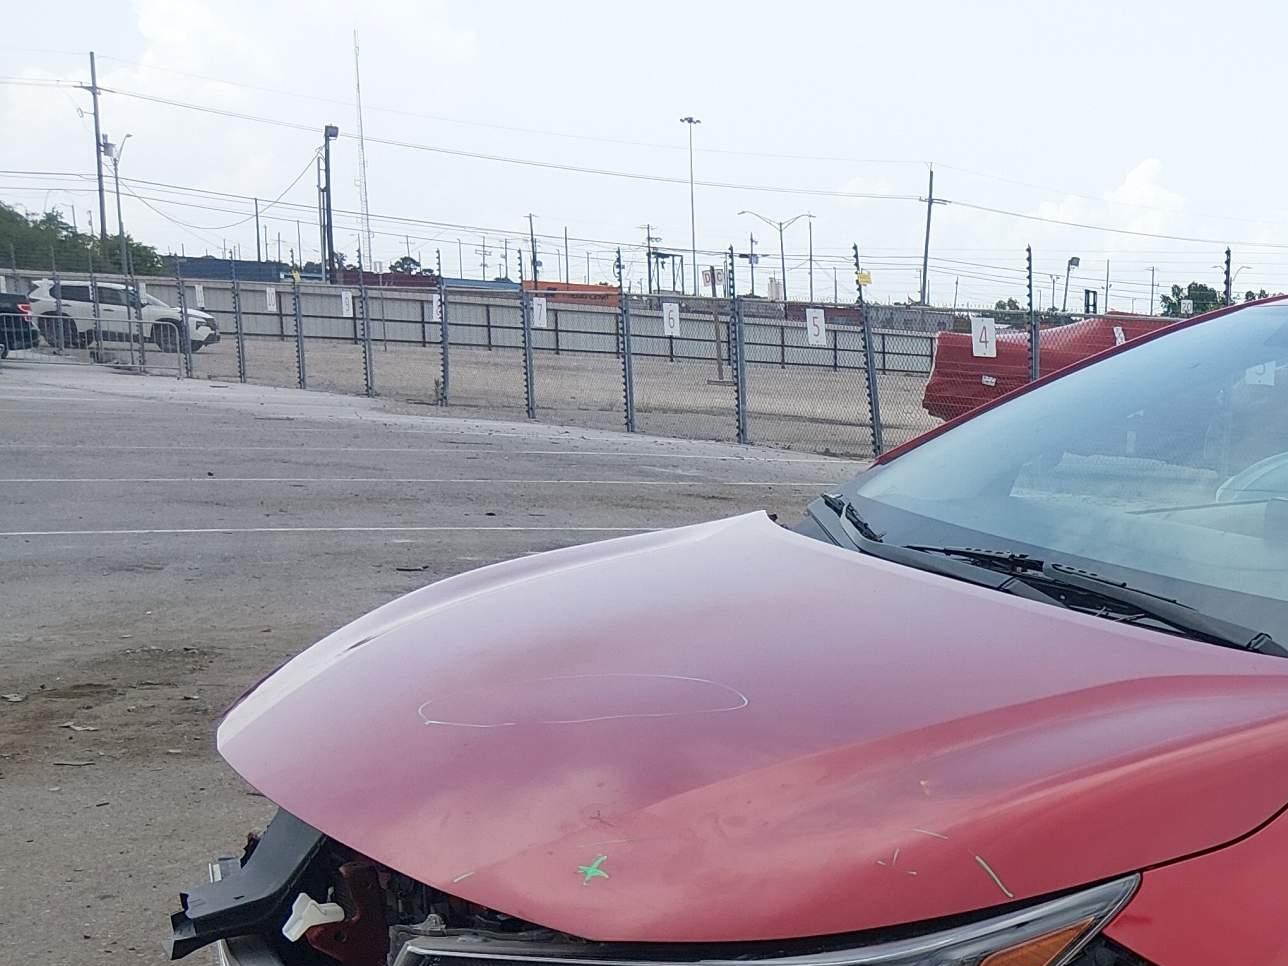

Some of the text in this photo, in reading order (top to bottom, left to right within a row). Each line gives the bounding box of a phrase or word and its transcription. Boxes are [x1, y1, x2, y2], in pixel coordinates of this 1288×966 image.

[668, 309, 675, 329] 6
[812, 316, 820, 337] 5
[979, 325, 989, 350] 4
